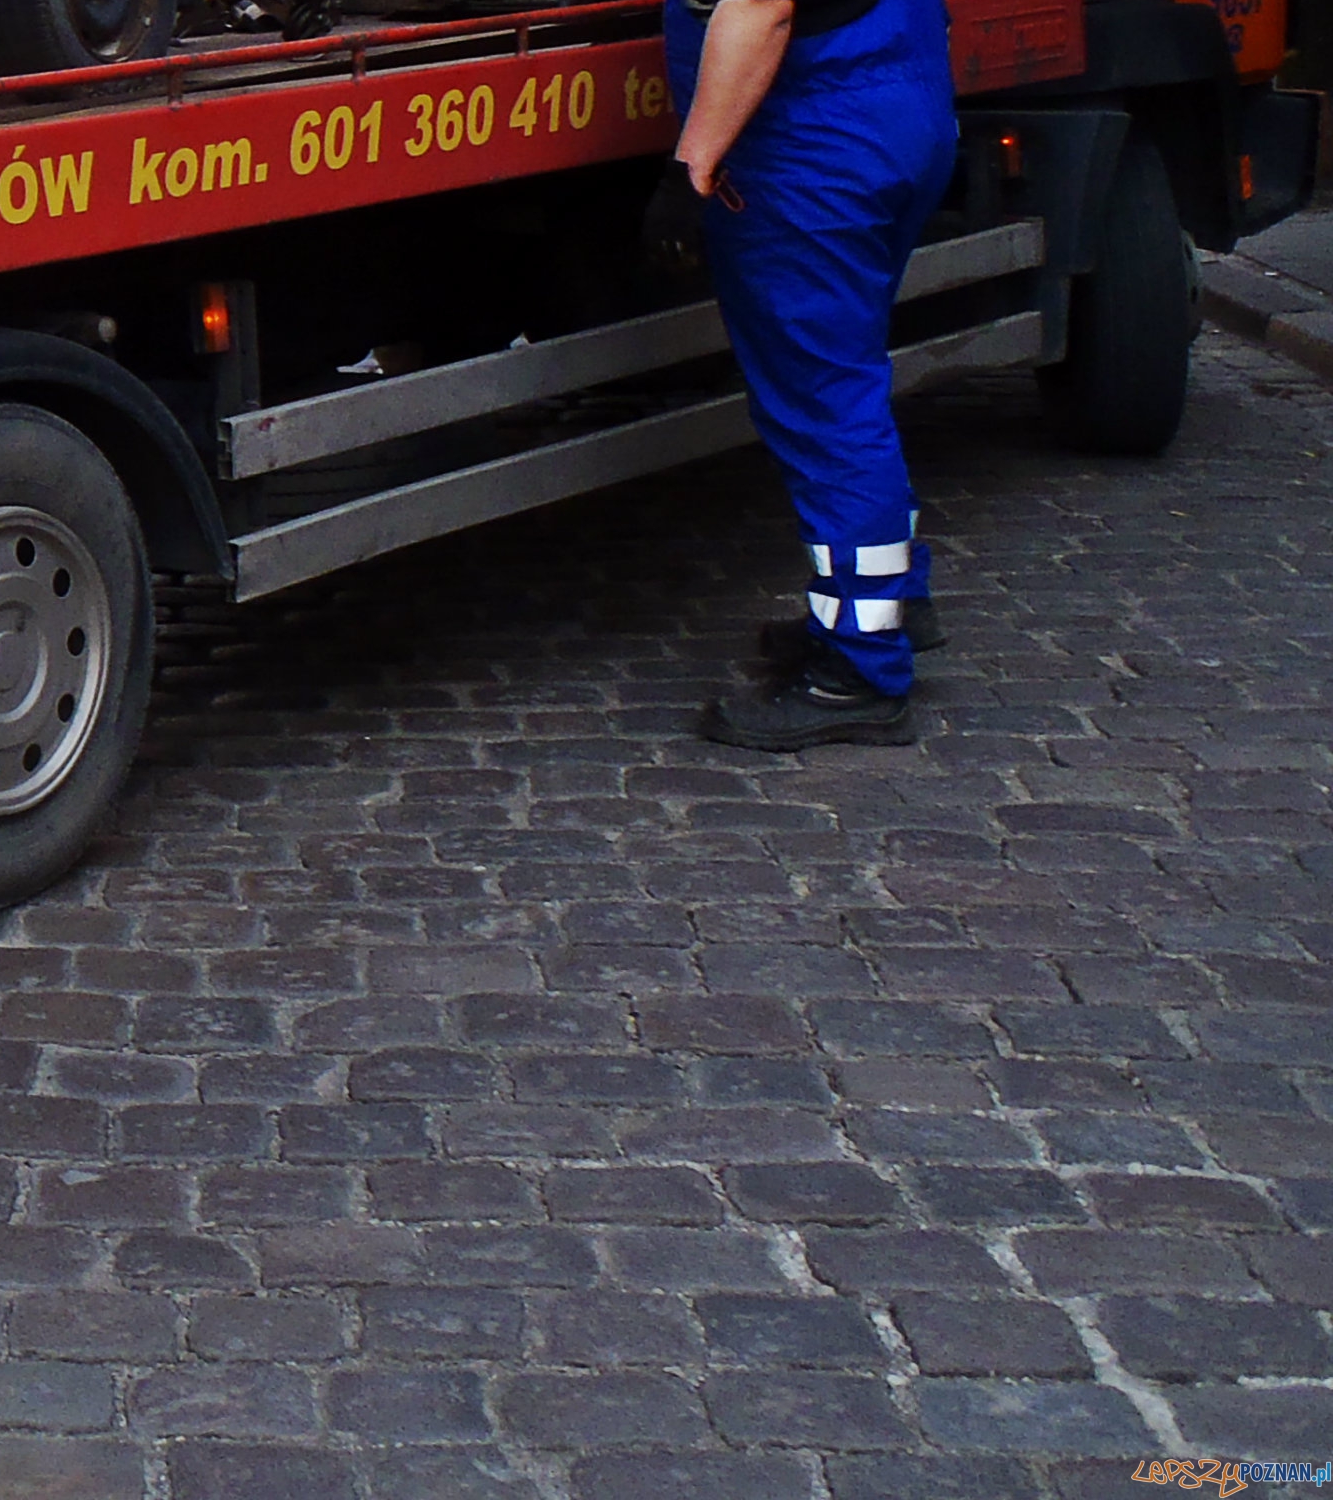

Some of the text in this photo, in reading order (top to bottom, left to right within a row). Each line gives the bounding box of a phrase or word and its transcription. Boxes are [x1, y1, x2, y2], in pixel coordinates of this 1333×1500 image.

[129, 137, 269, 205] kom.
[290, 100, 384, 175] 601
[404, 84, 494, 157] 360
[509, 70, 595, 137] 410
